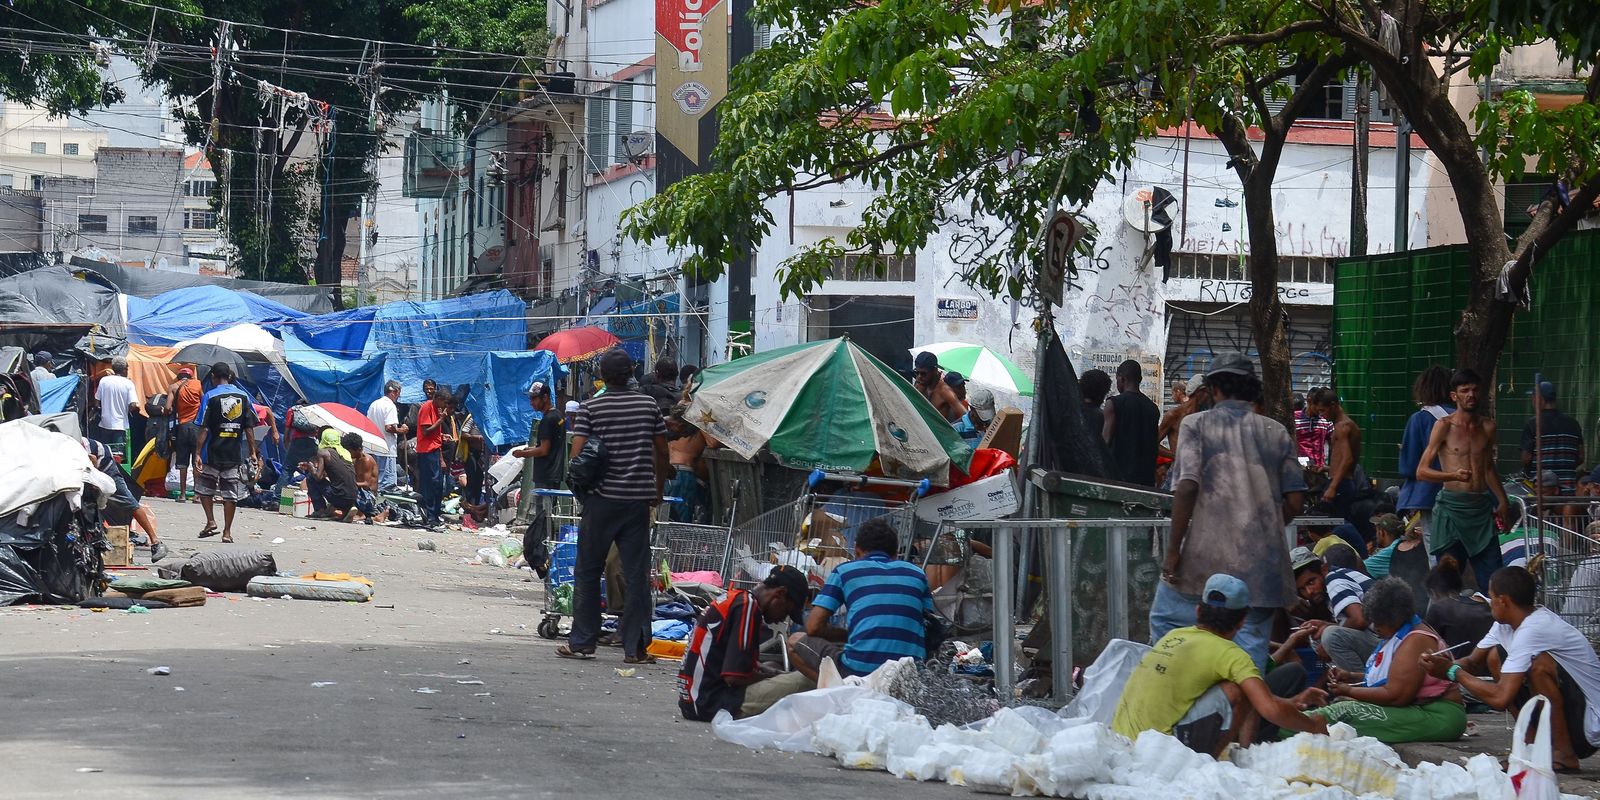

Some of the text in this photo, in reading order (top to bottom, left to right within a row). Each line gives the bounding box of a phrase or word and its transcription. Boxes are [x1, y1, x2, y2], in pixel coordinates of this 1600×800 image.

[945, 299, 971, 309] LARGO
[790, 457, 852, 471] Sony Ericsson
